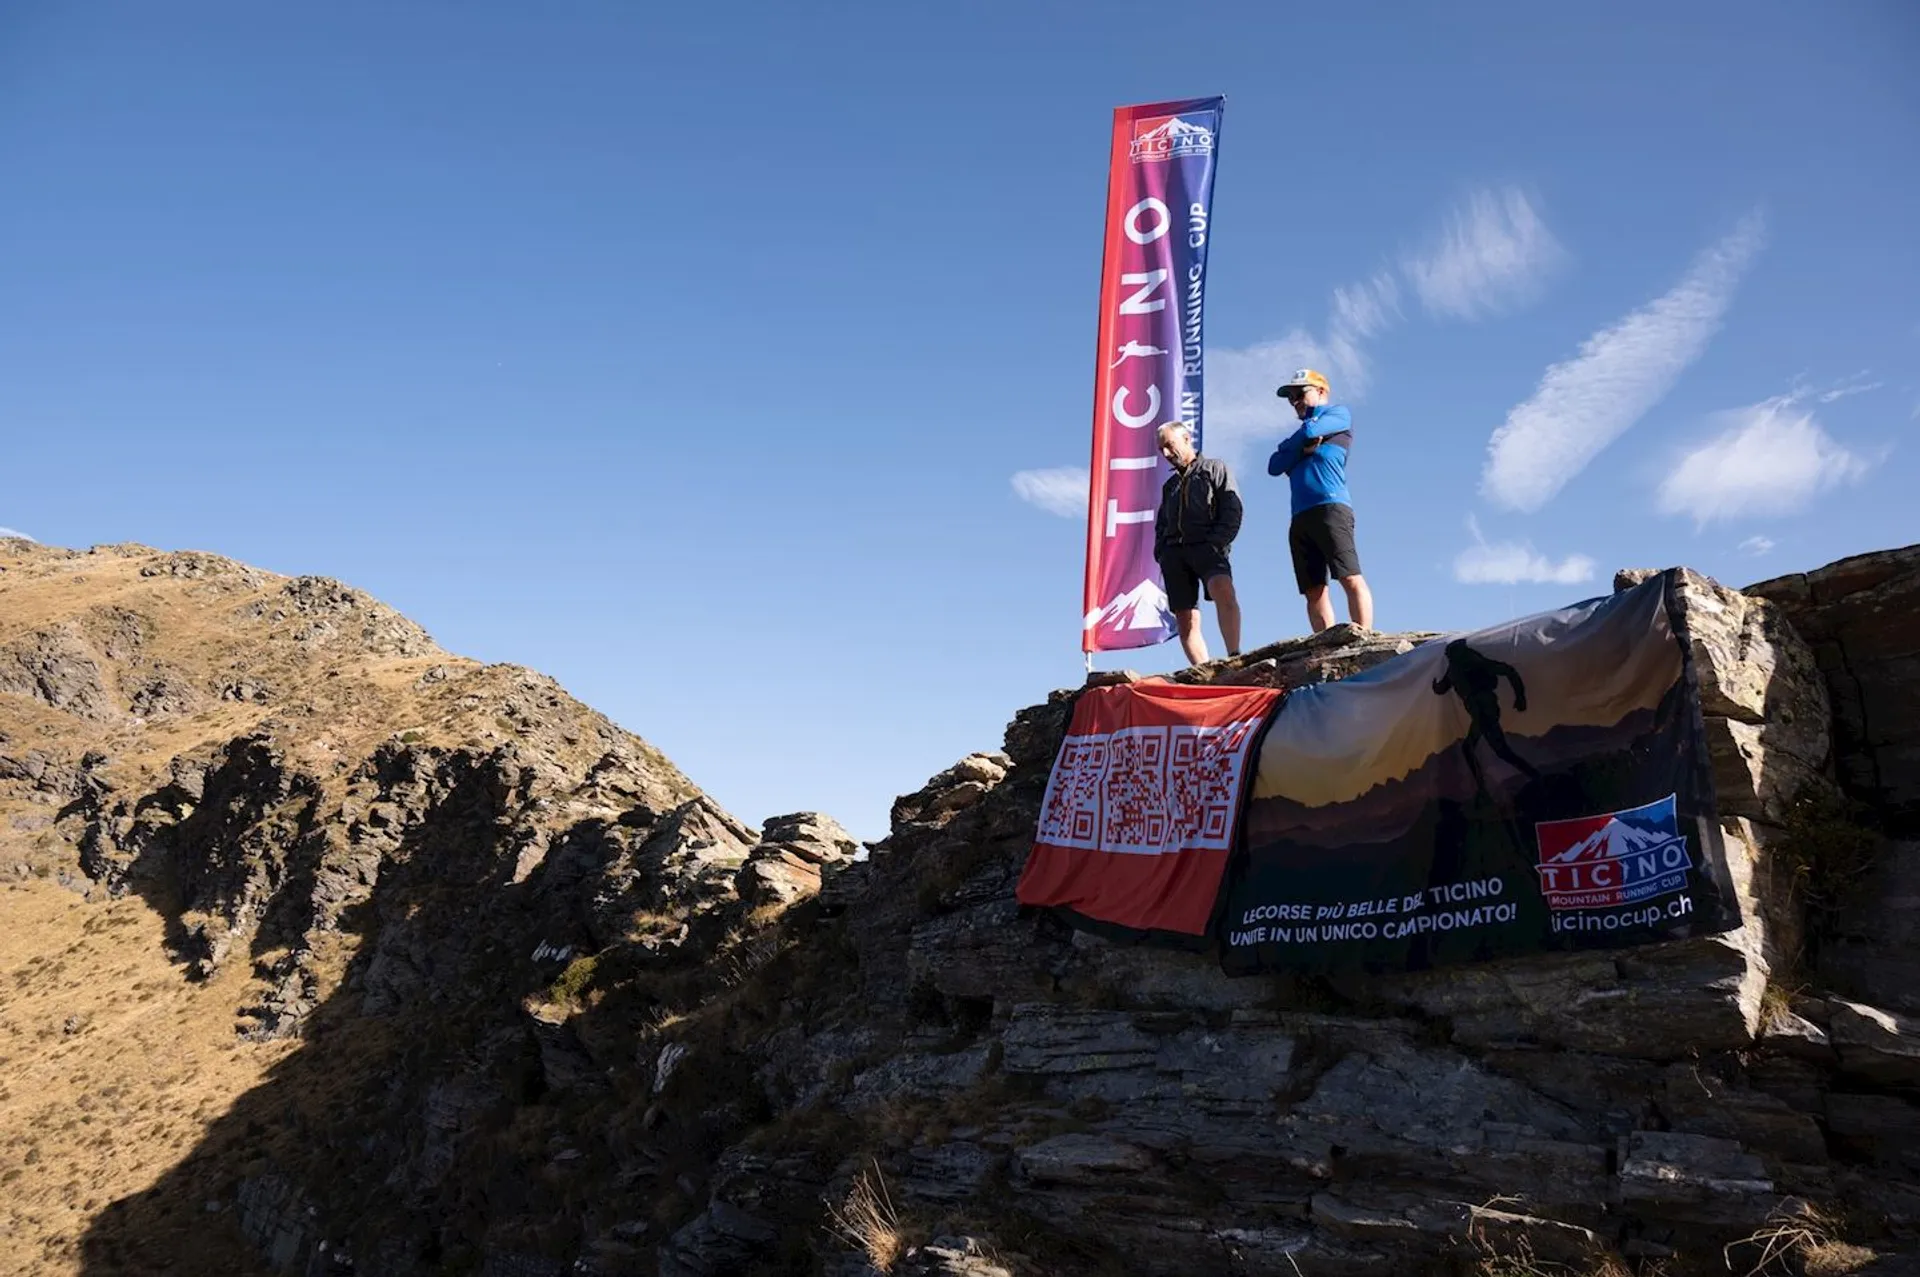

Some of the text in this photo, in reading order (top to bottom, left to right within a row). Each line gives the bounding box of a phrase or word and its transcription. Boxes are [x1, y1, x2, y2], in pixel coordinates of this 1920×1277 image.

[1188, 203, 1208, 248] CUP
[1183, 263, 1204, 377] RUNNING
[1316, 902, 1345, 921] PIÙ
[1346, 898, 1399, 919] BELLE
[1429, 877, 1504, 904] TICINO
[1552, 875, 1682, 906] MOUNTAIN RUNNING CUP
[1270, 926, 1291, 943] IN
[1295, 926, 1318, 944] UN
[1321, 922, 1378, 942] UNICO
[1382, 903, 1517, 939] CAMPIONATO!
